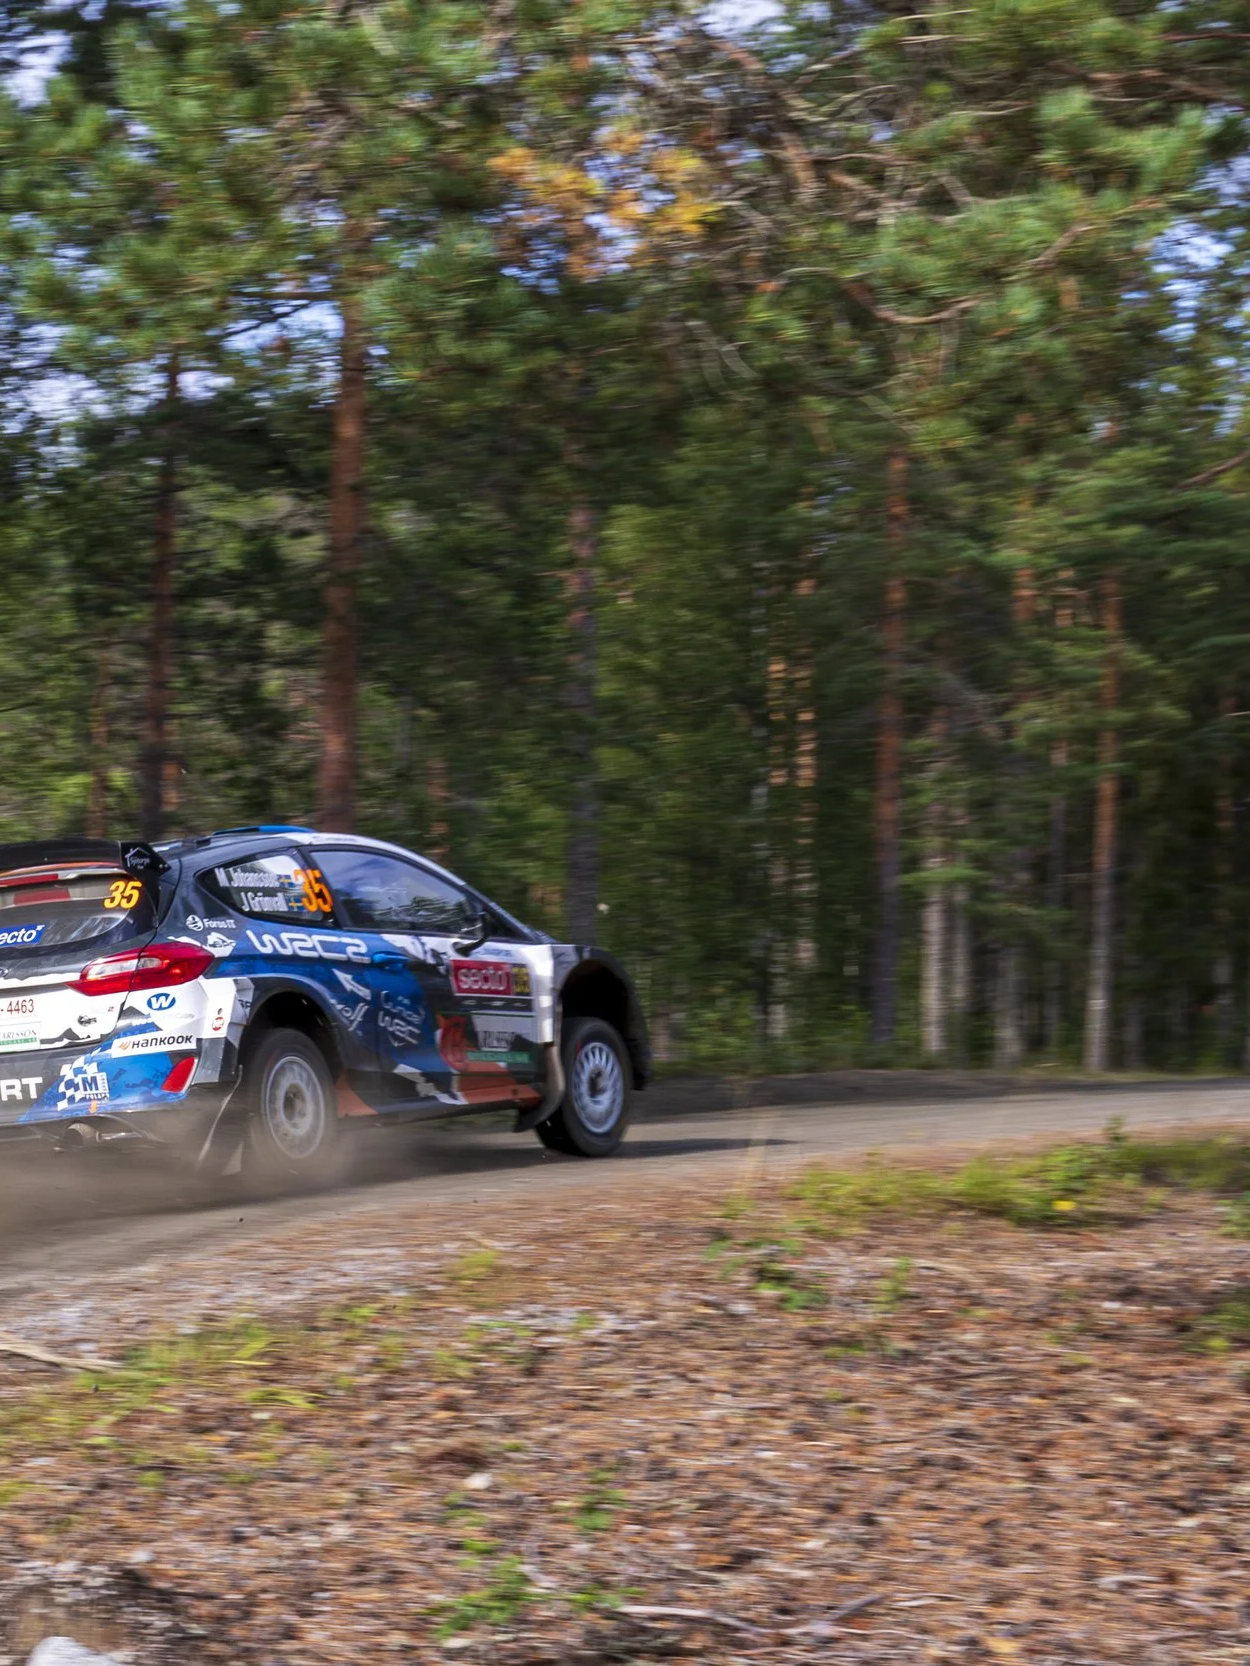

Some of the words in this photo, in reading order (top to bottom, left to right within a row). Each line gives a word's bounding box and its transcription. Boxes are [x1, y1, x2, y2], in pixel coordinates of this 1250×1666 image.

[103, 880, 143, 909] 35
[293, 868, 333, 912] 35
[457, 966, 508, 991] secto
[150, 993, 175, 1009] W
